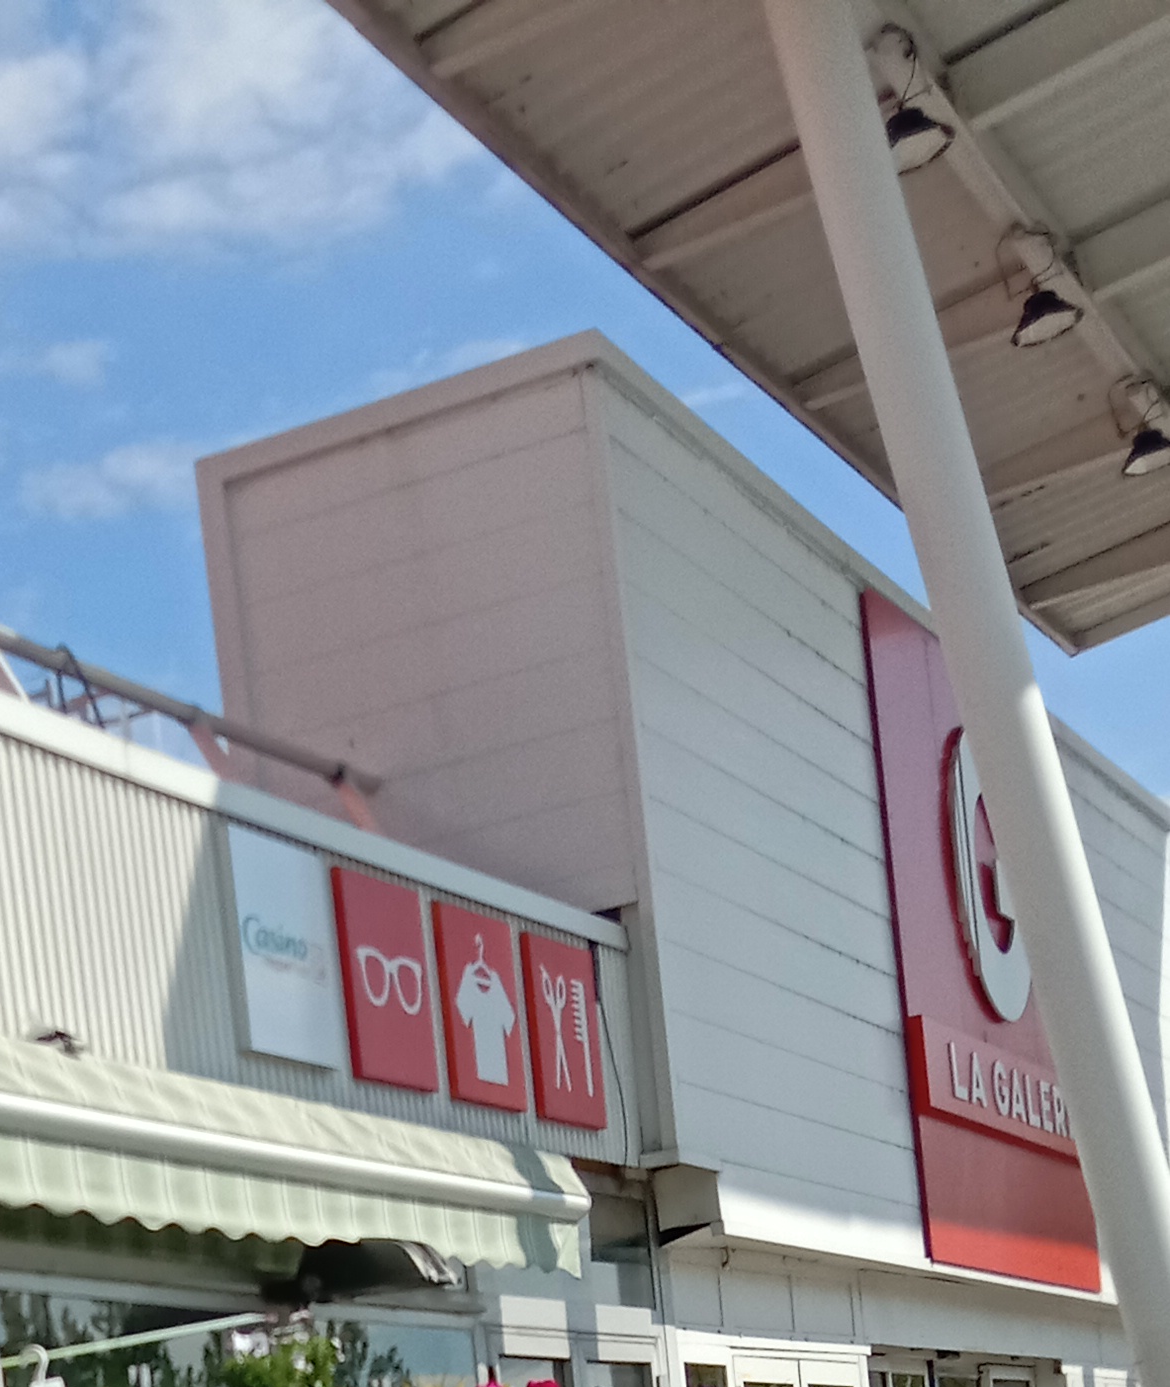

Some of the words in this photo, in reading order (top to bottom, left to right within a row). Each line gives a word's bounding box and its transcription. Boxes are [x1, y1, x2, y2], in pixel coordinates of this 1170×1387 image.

[241, 914, 308, 961] Casino
[947, 1040, 988, 1109] LA
[991, 1059, 1071, 1140] GALER
